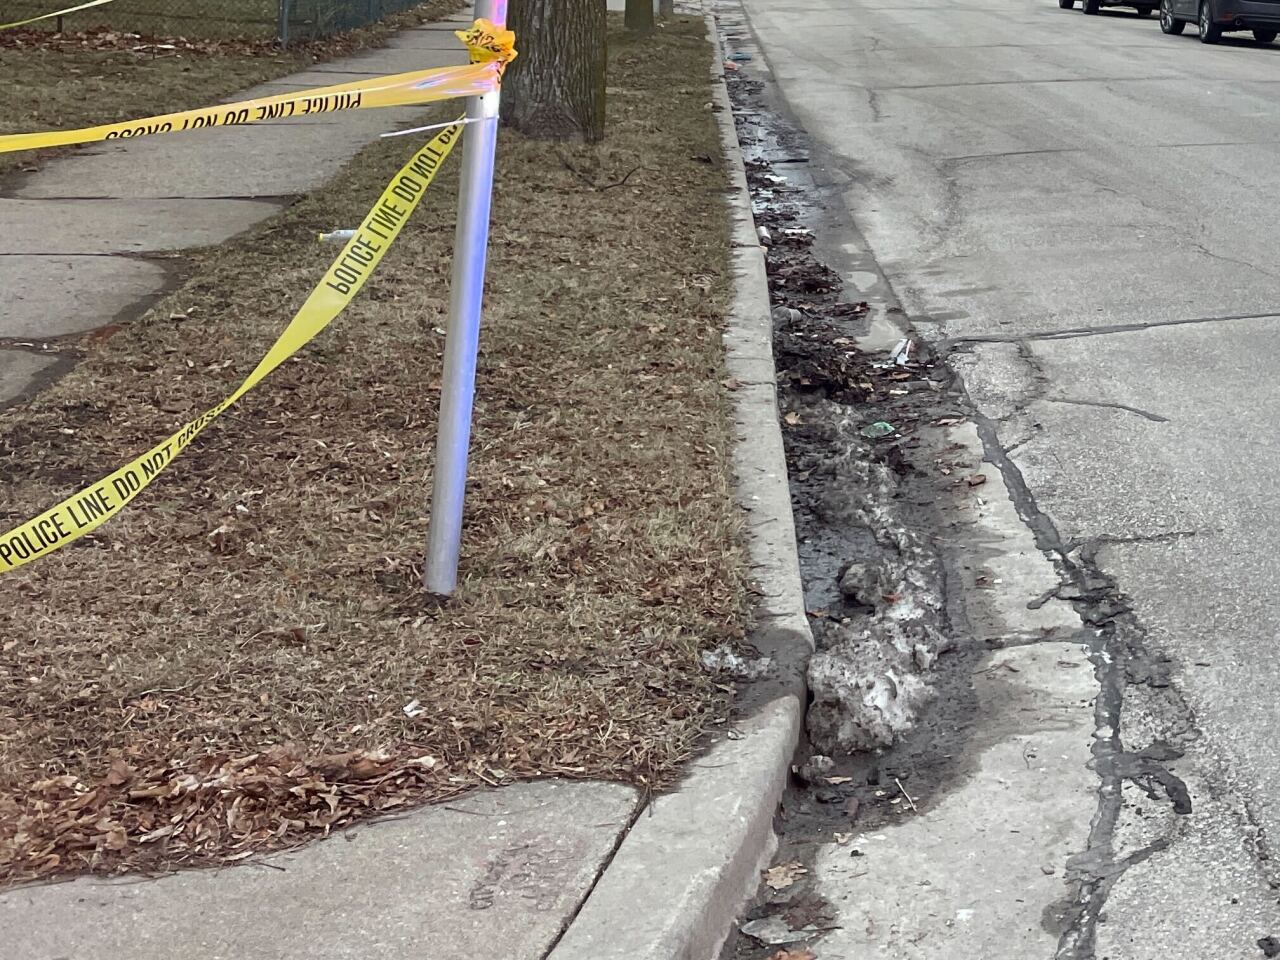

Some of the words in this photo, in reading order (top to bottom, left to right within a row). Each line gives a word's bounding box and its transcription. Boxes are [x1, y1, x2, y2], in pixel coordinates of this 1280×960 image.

[0, 512, 72, 566] POLICE
[66, 486, 116, 529] LINE
[111, 470, 141, 501] DO
[140, 442, 173, 481] NOT
